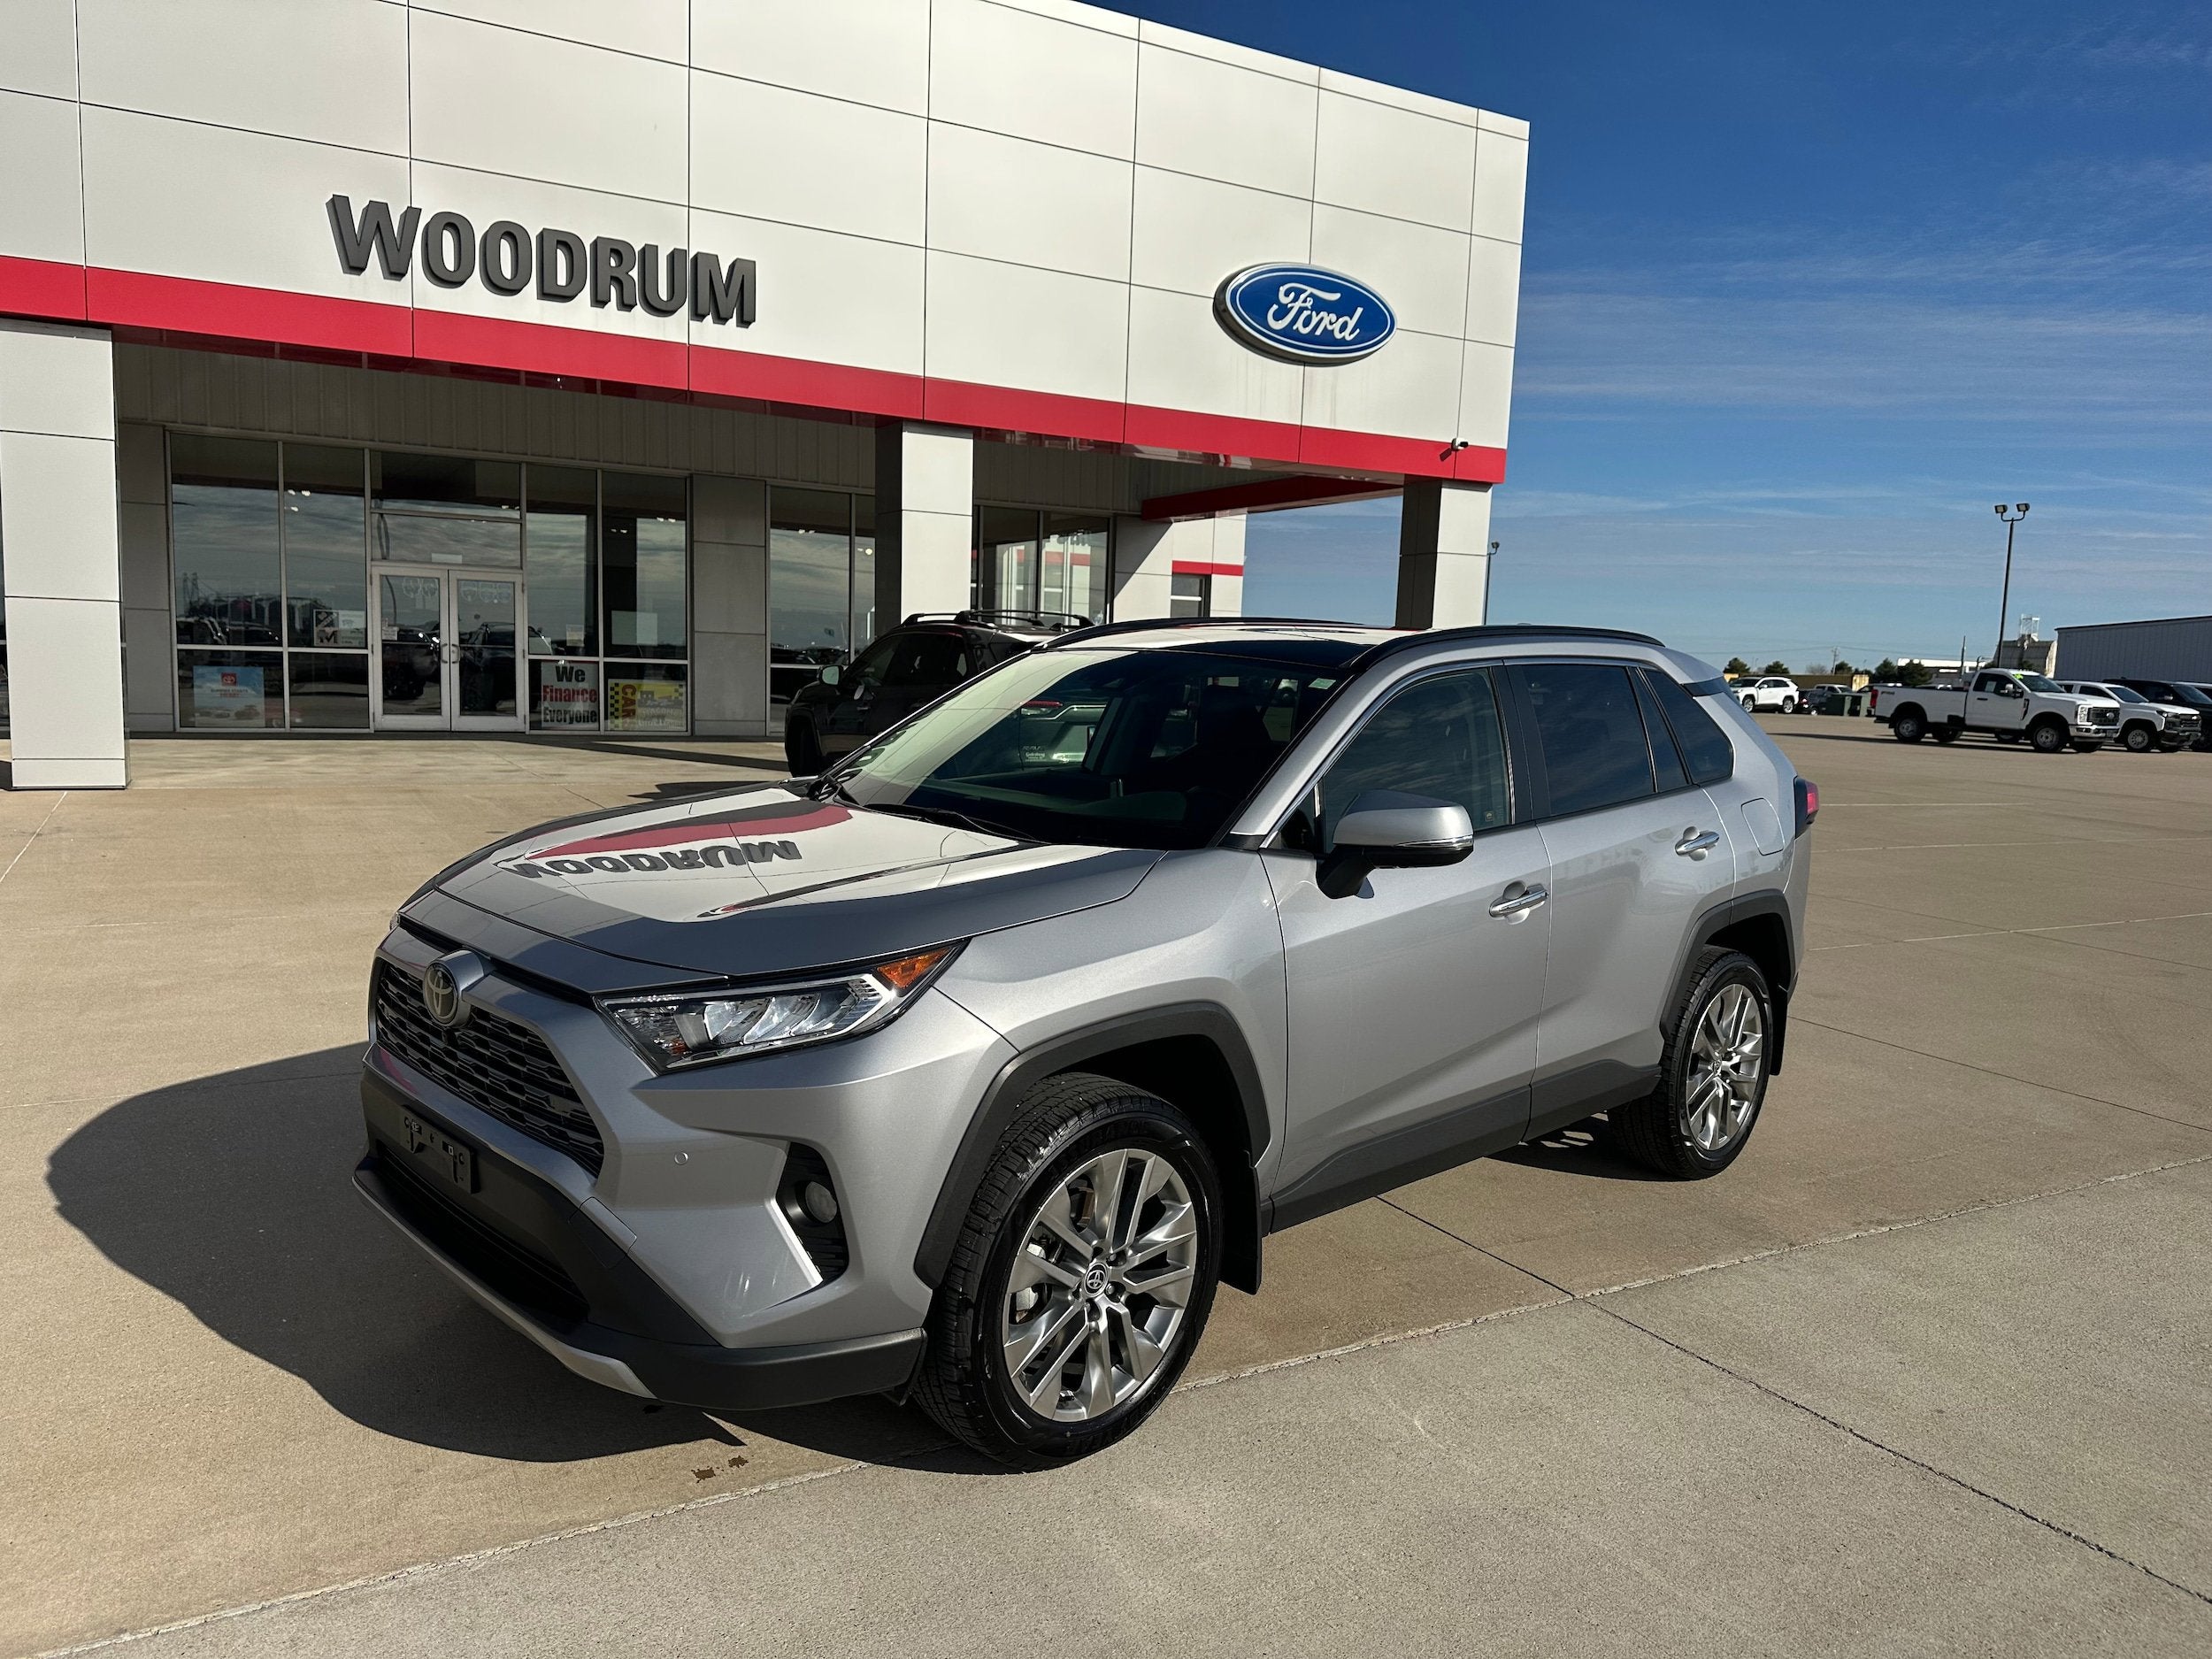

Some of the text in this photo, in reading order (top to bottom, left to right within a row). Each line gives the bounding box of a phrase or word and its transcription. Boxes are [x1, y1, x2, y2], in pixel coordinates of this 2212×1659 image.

[326, 194, 757, 328] WOODRUM
[1267, 282, 1363, 342] Ford
[555, 665, 586, 682] We
[542, 685, 597, 703] Finance
[543, 707, 597, 725] Everyone
